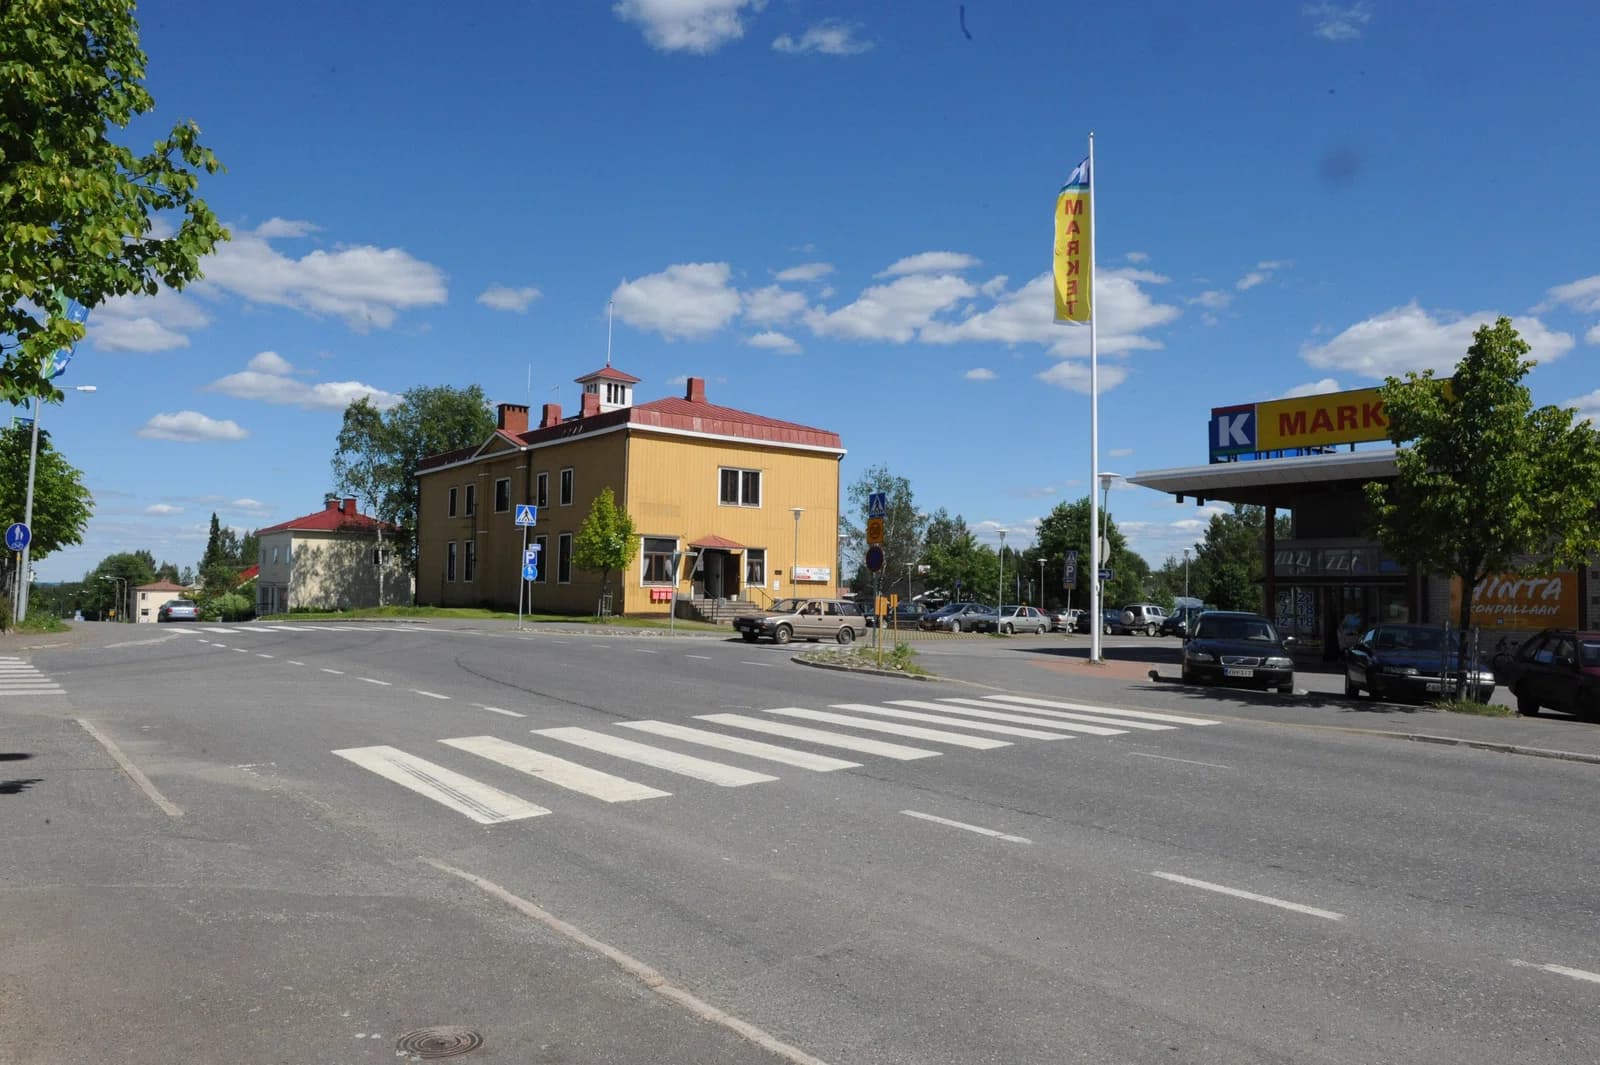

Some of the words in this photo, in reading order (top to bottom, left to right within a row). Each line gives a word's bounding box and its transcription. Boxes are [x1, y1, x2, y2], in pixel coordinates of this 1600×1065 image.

[1218, 412, 1251, 447] K
[1279, 401, 1390, 437] MARK
[526, 551, 535, 564] P
